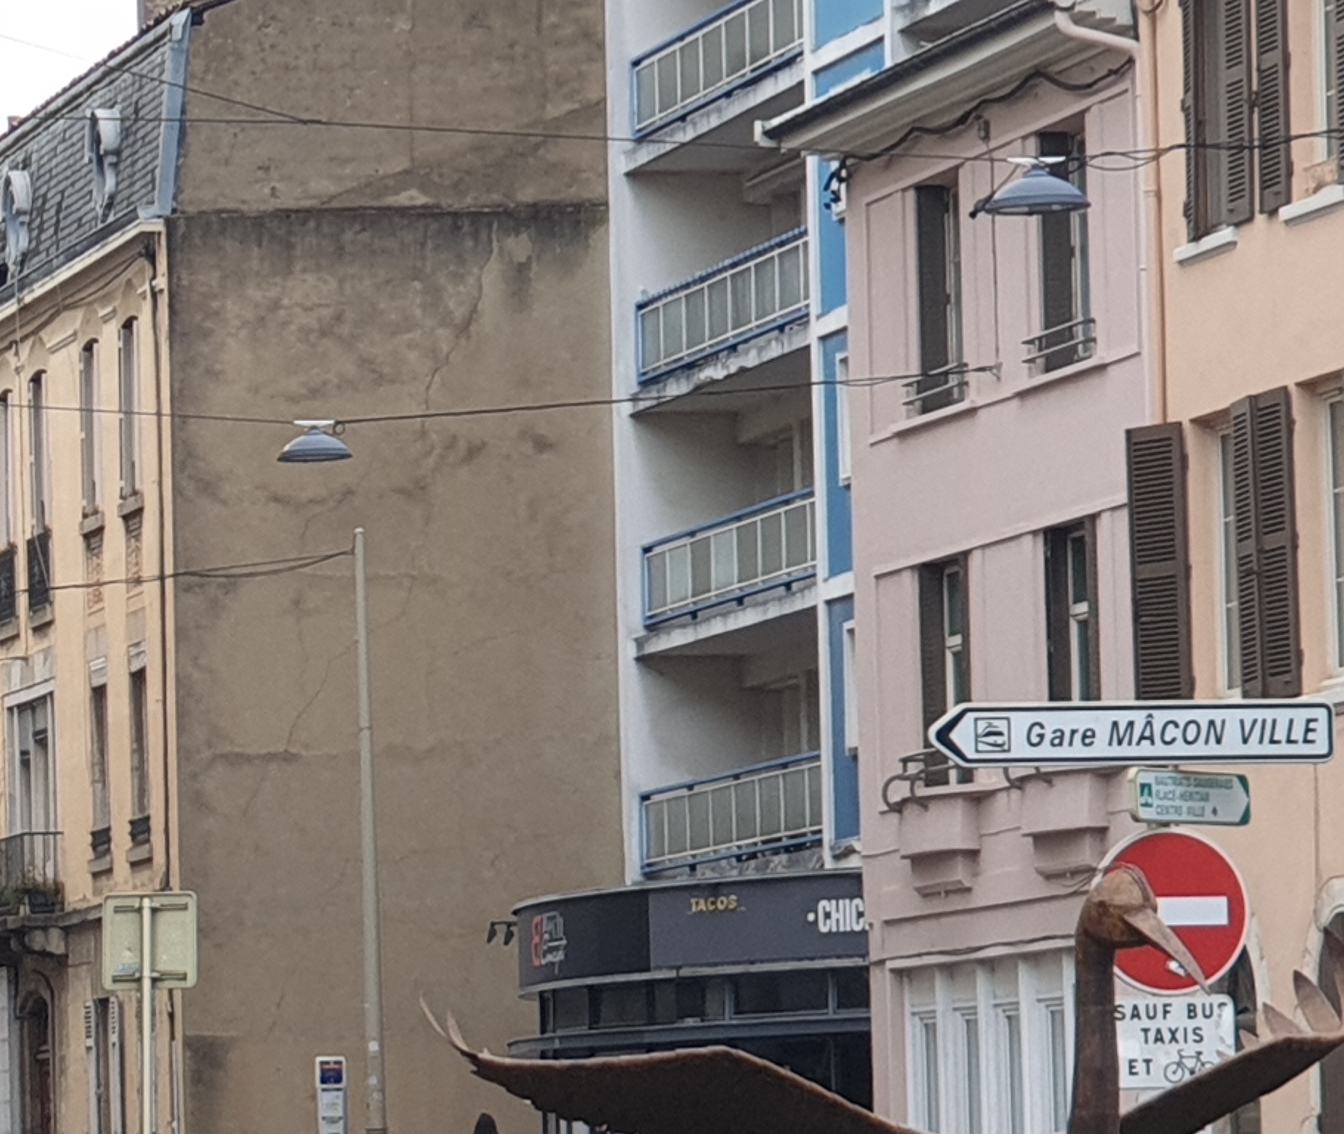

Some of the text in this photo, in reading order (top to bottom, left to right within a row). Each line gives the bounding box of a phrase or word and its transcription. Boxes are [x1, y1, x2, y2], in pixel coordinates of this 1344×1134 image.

[1025, 713, 1320, 748] Gare MÂCON VILLE
[690, 894, 738, 913] TACOS
[1114, 1002, 1173, 1021] SAUF
[1140, 1026, 1205, 1044] TAXIS
[1128, 1058, 1154, 1076] ET
